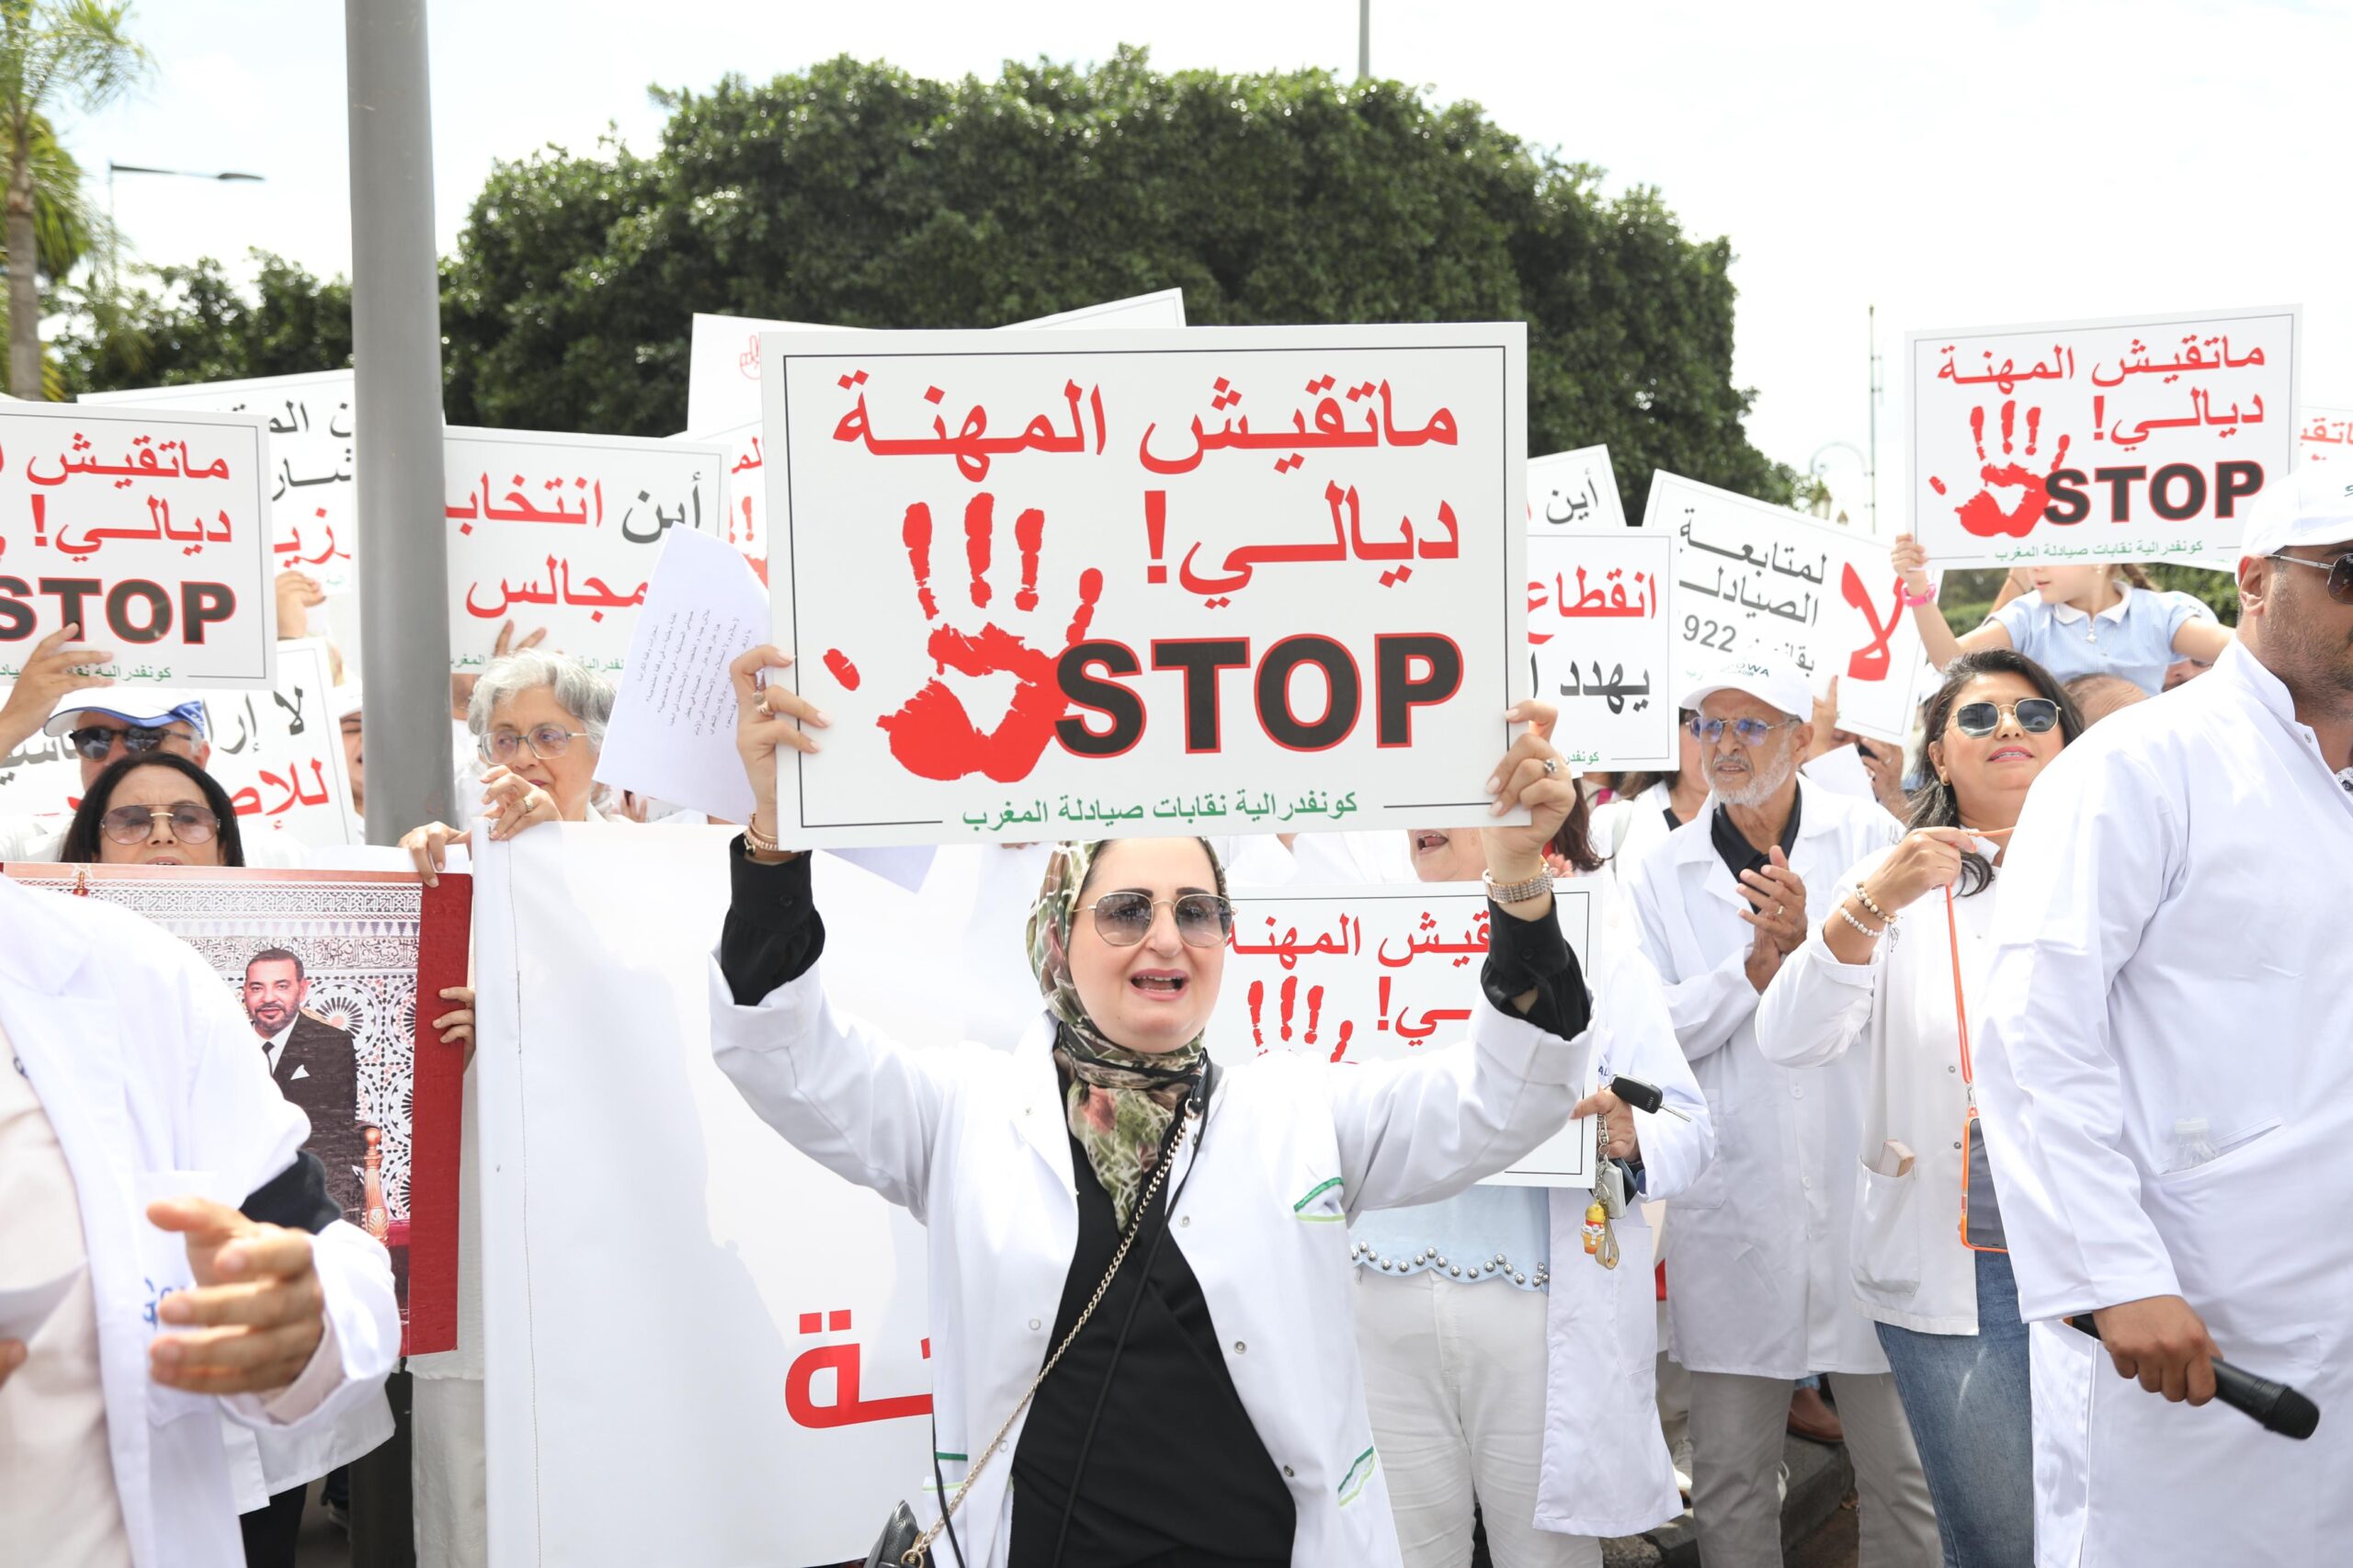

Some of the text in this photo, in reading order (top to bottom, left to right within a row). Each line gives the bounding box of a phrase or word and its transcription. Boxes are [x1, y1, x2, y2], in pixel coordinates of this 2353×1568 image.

[1937, 333, 2266, 395] ماتقيش المهنة
[832, 369, 1459, 483] ماتقيش المهنة
[2092, 387, 2265, 453] ديالي!
[2300, 415, 2353, 450] اتقي
[26, 432, 230, 489] ماتقيش
[446, 471, 603, 536] انتخاب
[1546, 468, 1599, 525] أين
[2042, 460, 2265, 527] STOP
[30, 494, 233, 562] ديالي!
[1144, 479, 1460, 609] ديالي!
[1679, 508, 1828, 585] لمتابعة
[1993, 546, 2041, 562] المغرب
[2094, 540, 2133, 557] نقابات
[2137, 539, 2204, 559] كونفدرالية
[0, 575, 236, 649] STOP
[1528, 564, 1657, 646] انقطاع
[1679, 564, 1819, 630] الصيادل
[1841, 562, 1908, 682] لا
[273, 686, 304, 735] لا
[1054, 631, 1464, 759] STOP
[1560, 661, 1651, 715] يهدد
[202, 692, 261, 755] إرا
[1564, 750, 1600, 766] كونفدر
[961, 790, 1358, 832] كونفدرالية نقابات صيادلة المغرب
[1378, 910, 1491, 969] قيش
